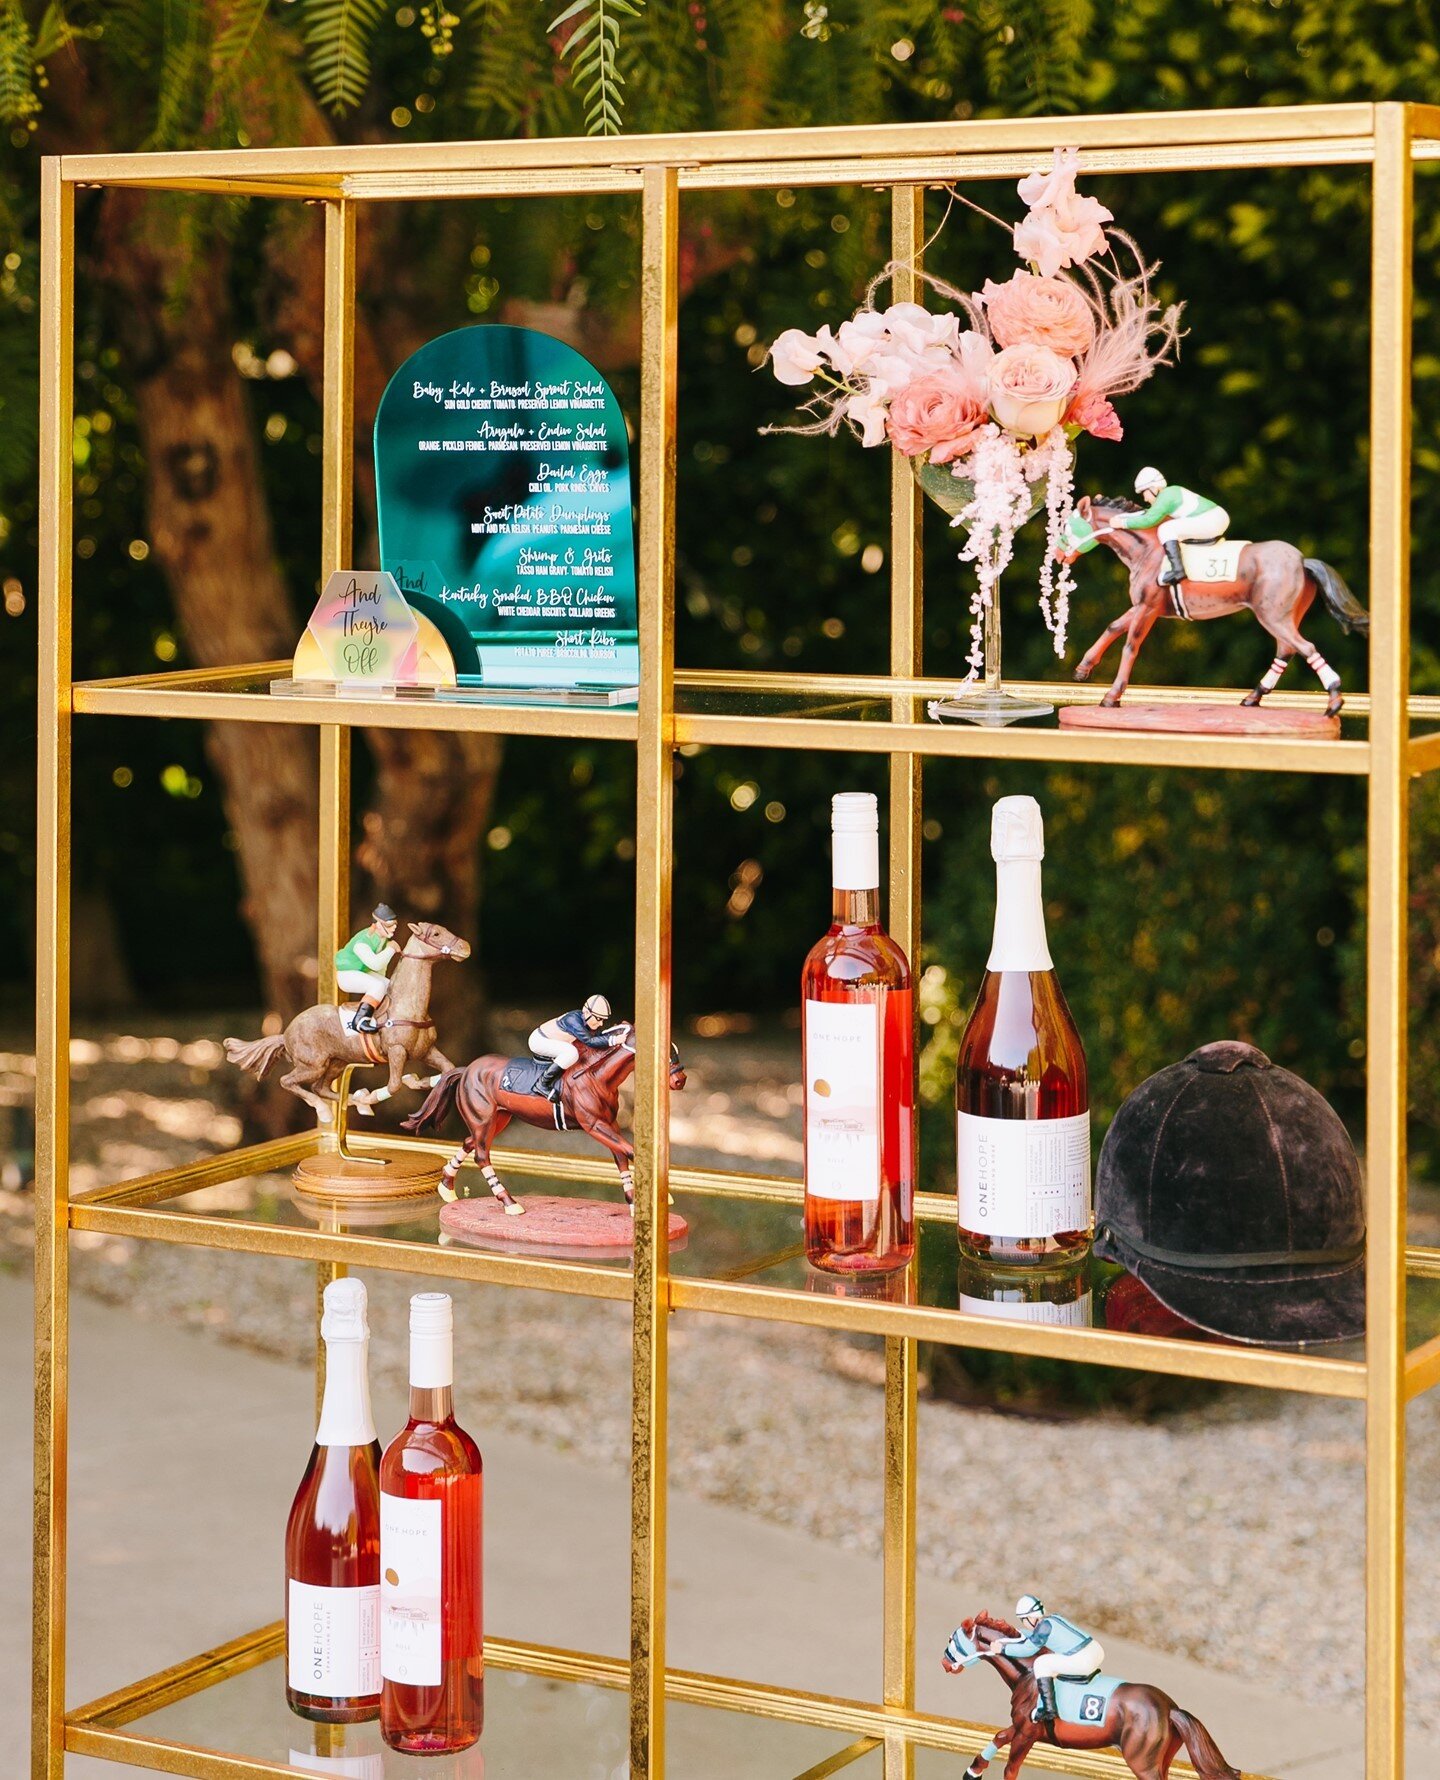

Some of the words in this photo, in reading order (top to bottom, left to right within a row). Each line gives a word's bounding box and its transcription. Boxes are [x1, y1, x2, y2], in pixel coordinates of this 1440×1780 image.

[413, 381, 443, 403] Baby
[449, 380, 475, 398] Kale
[490, 380, 531, 398] Brussel
[535, 380, 572, 400] Sprout
[573, 380, 604, 400] Salad
[444, 400, 455, 409] SUN
[456, 400, 470, 409] GOLD
[471, 400, 491, 409] CHERRY
[518, 399, 548, 409] PRESERVED
[550, 399, 568, 409] LEMON
[477, 420, 524, 442] Arugula
[538, 422, 572, 440] Endive
[576, 422, 606, 441] Salad
[443, 441, 464, 451] PICKLED
[520, 441, 551, 451] PRESERVED
[552, 441, 570, 451] LEMON
[537, 462, 576, 481] Deviled
[580, 464, 608, 484] Eggs
[484, 505, 512, 524] Sweet
[514, 503, 545, 523] Potato
[550, 504, 610, 527] Dumplings
[519, 547, 558, 567] Shrimp
[565, 547, 574, 564] &
[582, 547, 612, 568] Grits
[1205, 559, 1230, 577] 31
[516, 565, 534, 575] TASSO
[535, 565, 548, 575] HAM
[571, 566, 593, 576] TOMATO
[595, 566, 614, 576] RELISH
[339, 579, 382, 607] And
[439, 584, 488, 609] Kentucky
[492, 584, 532, 606] Smoked
[537, 586, 573, 605] BBQ
[576, 585, 615, 605] Chicken
[497, 606, 515, 616] WHITE
[516, 606, 540, 616] CHEDDAR
[568, 607, 593, 617] COLLARD
[594, 607, 616, 618] GREENS
[555, 630, 586, 647] Short
[589, 627, 616, 648] Ribs
[344, 644, 378, 674] Off
[502, 1075, 511, 1087] 2
[978, 1133, 988, 1217] ONEHOPE
[313, 1602, 323, 1680] ONEHOPE
[1085, 1697, 1100, 1720] 8
